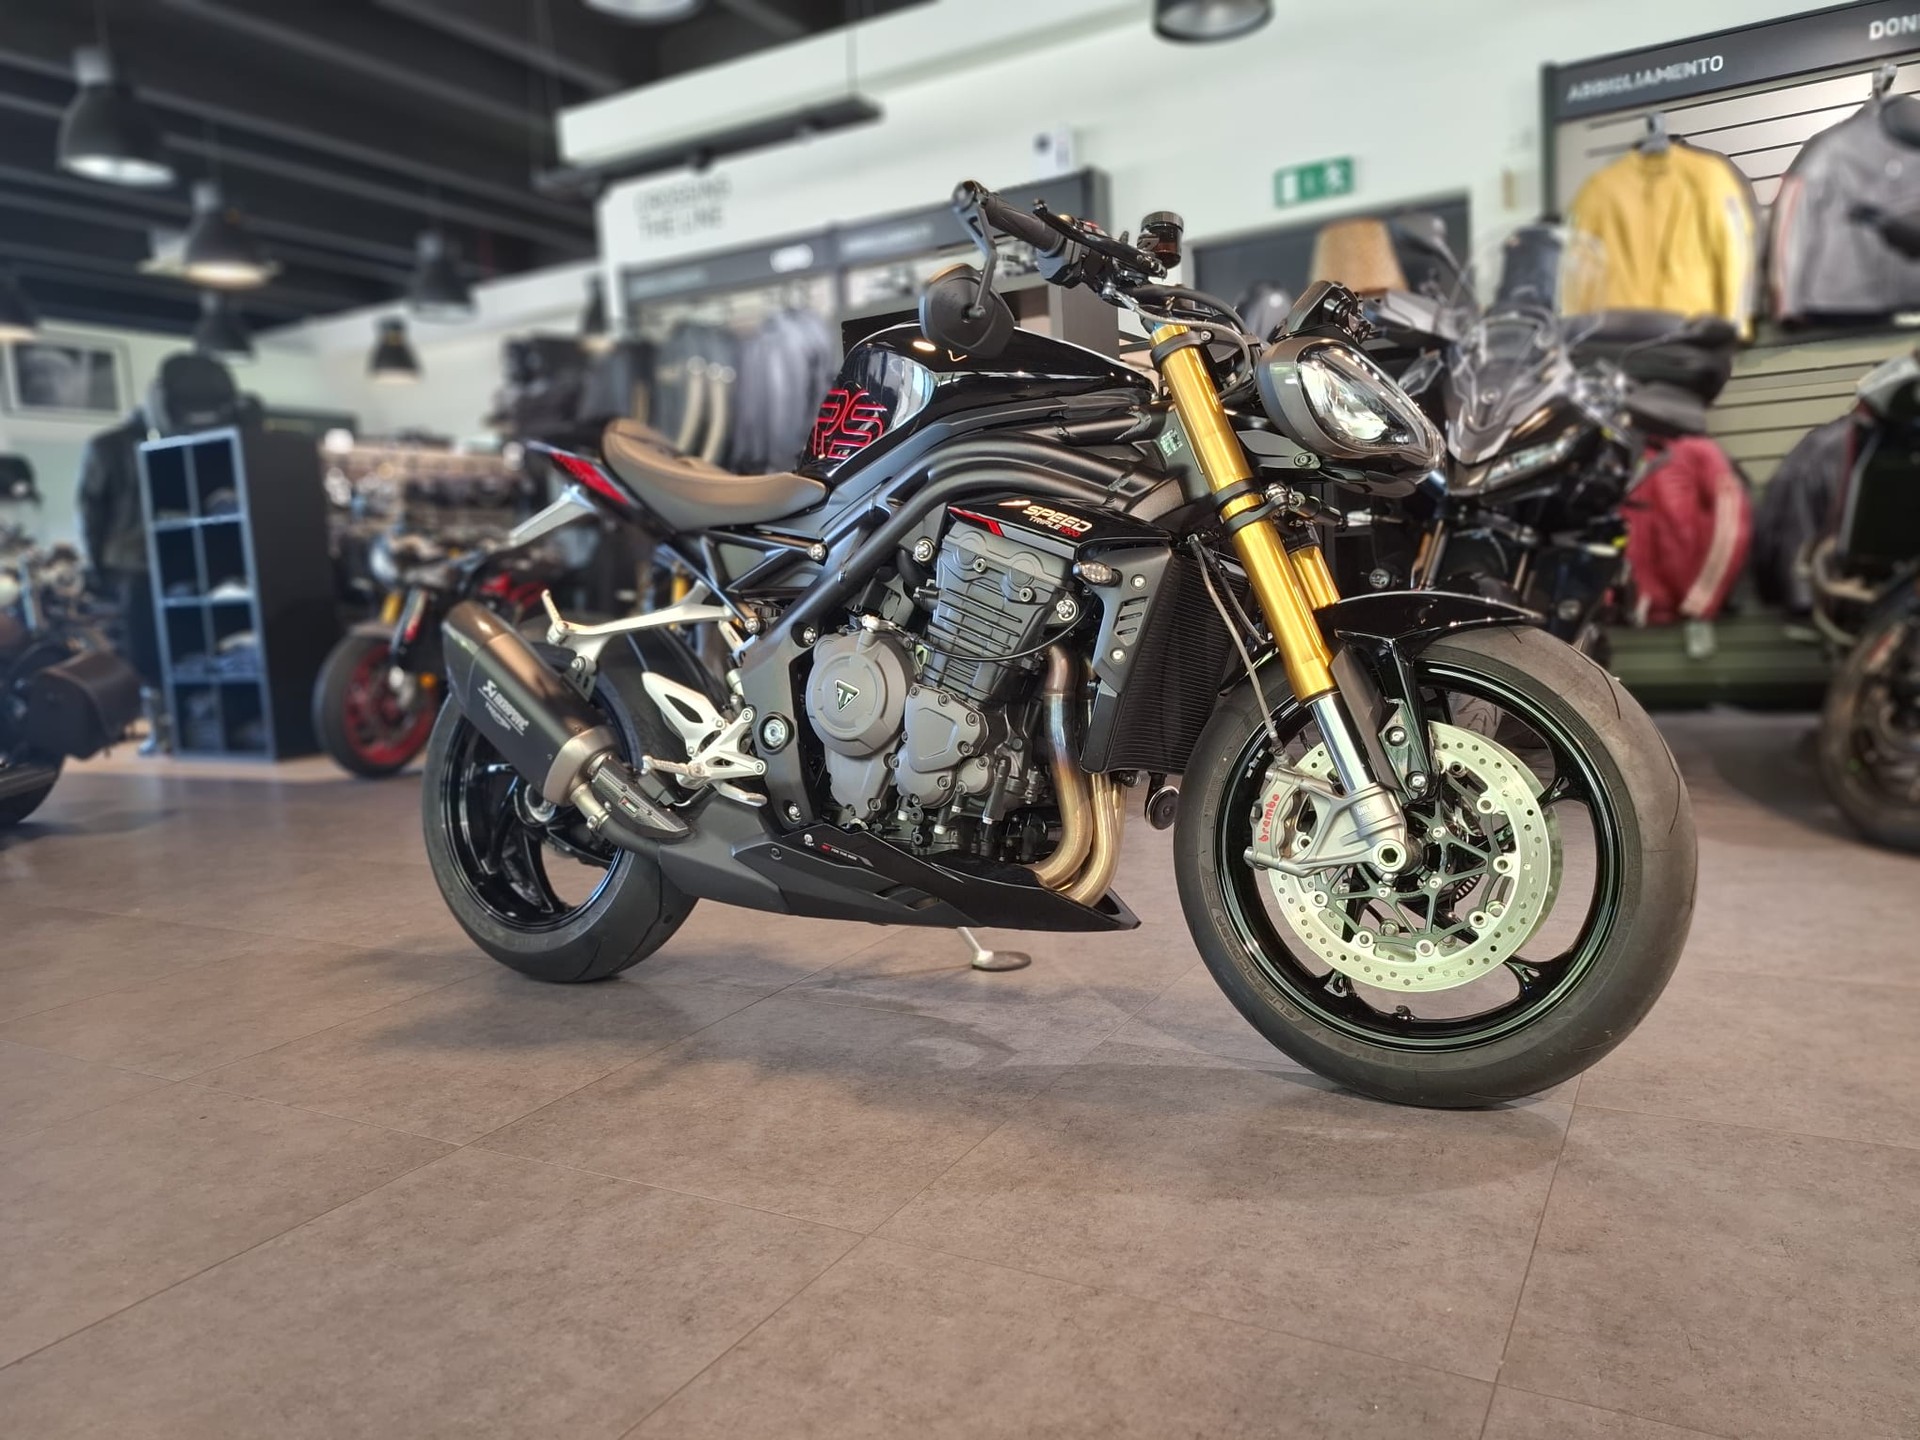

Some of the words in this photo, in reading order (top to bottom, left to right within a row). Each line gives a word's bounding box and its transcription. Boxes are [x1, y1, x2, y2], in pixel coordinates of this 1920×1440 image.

[1869, 13, 1920, 40] DON
[1022, 505, 1093, 533] SPEED
[1029, 516, 1061, 530] TRIPLE
[1258, 793, 1280, 843] brembo
